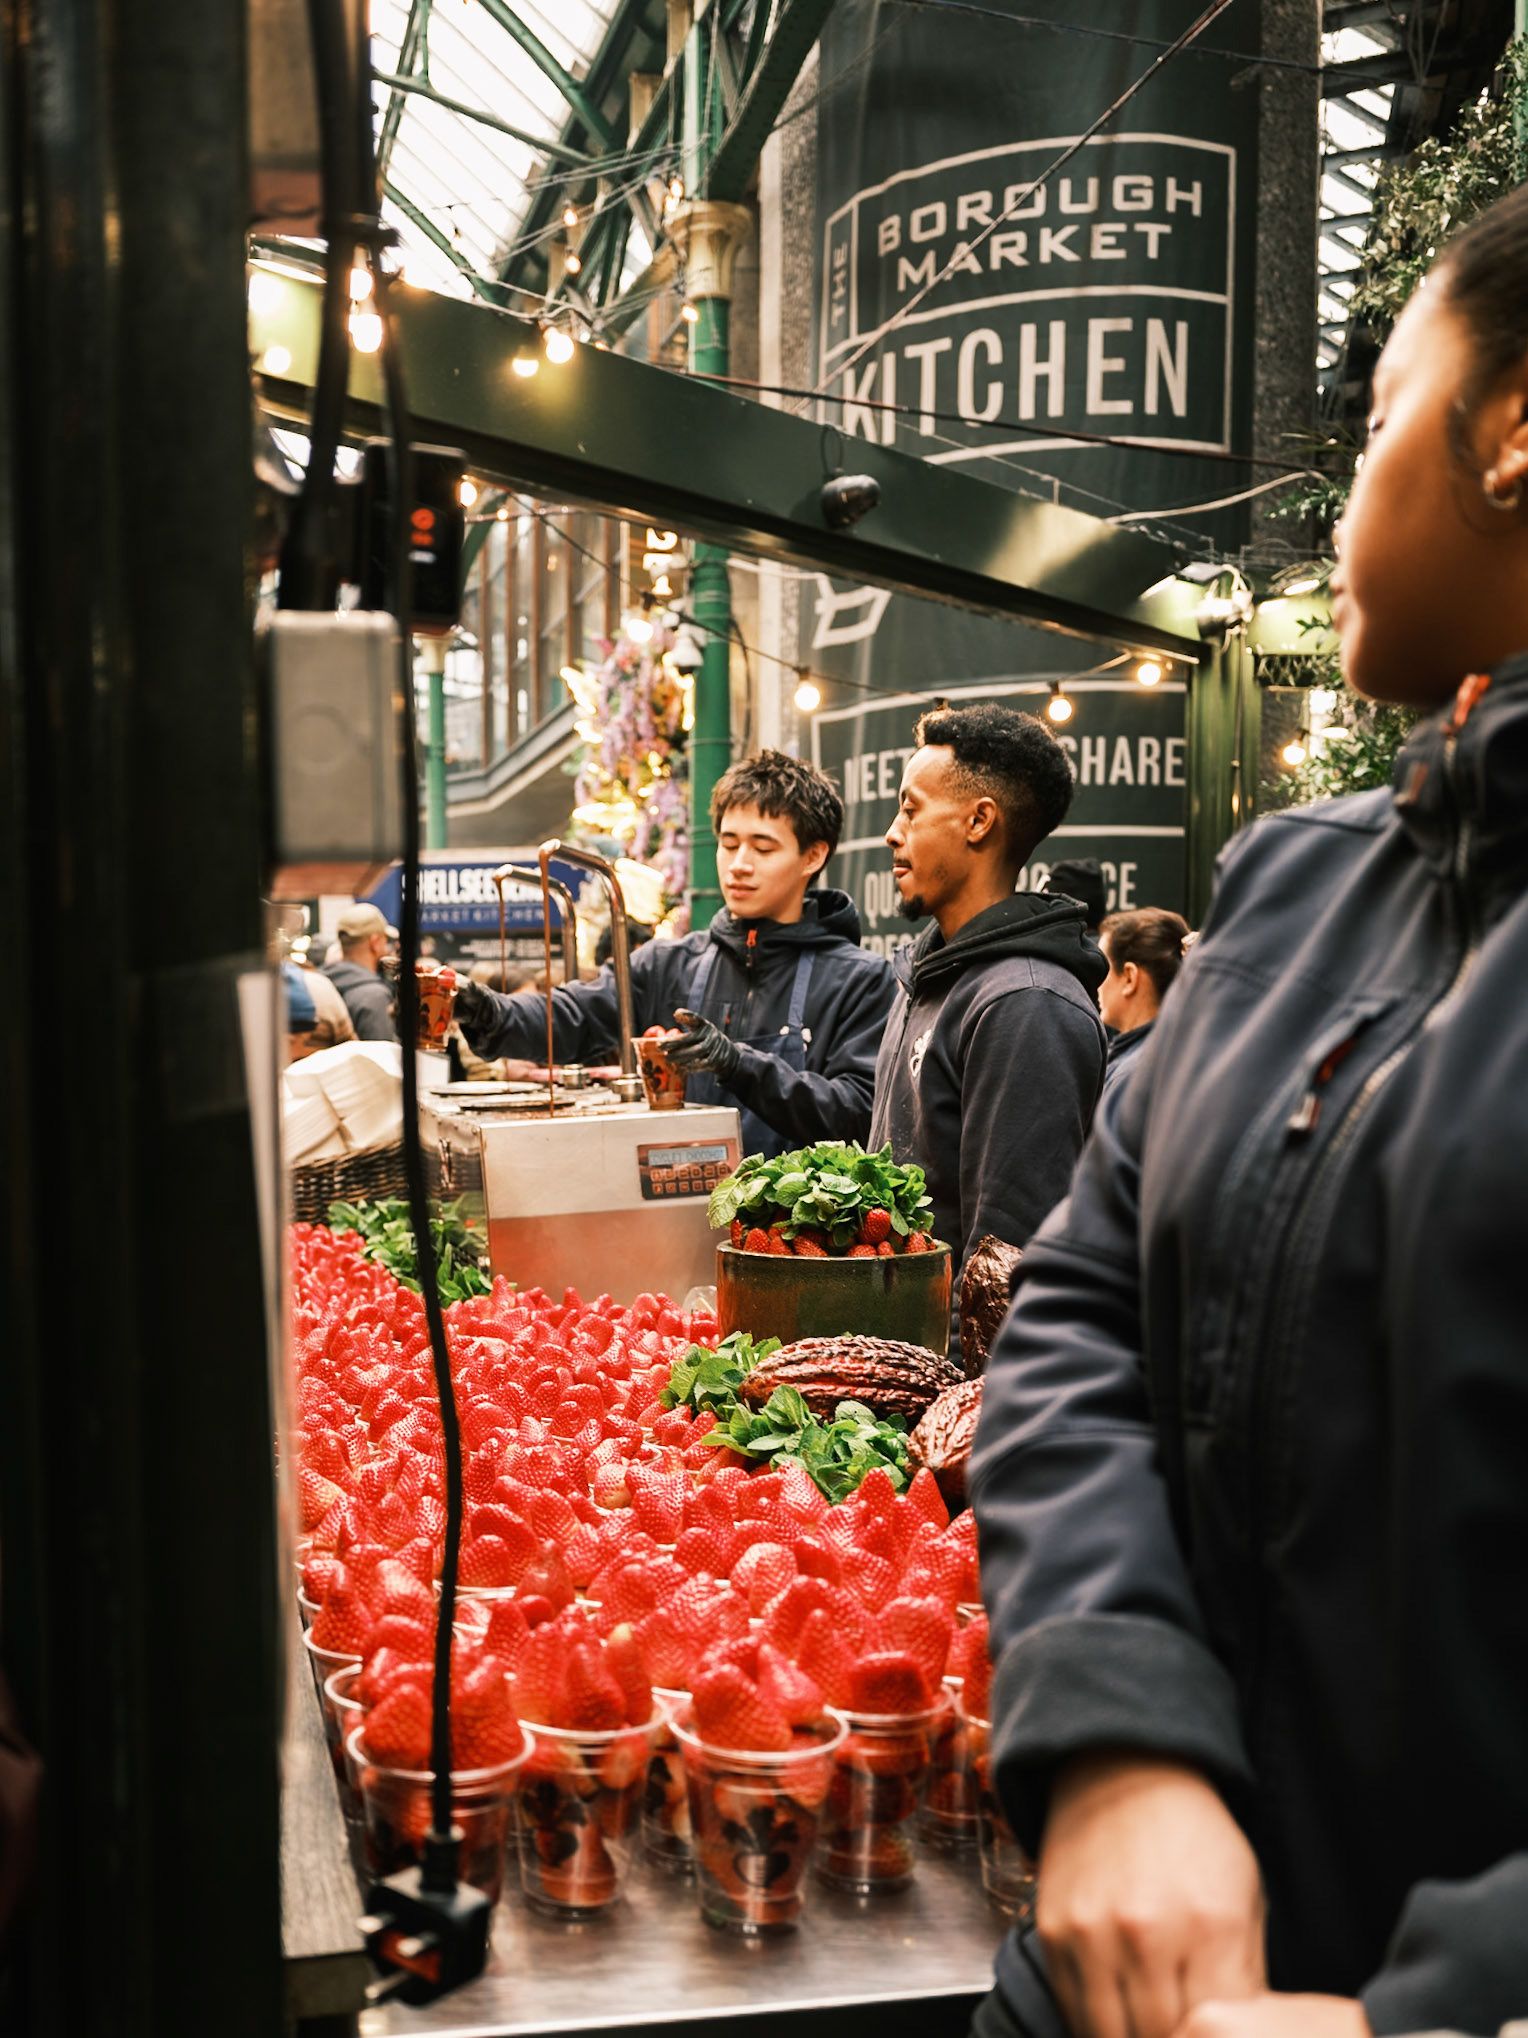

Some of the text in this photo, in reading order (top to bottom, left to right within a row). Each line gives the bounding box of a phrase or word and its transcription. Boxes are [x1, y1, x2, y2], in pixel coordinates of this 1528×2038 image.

[877, 174, 1202, 257] BOROUGH
[897, 222, 1172, 292] MARKET
[831, 242, 848, 328] THE
[842, 317, 1189, 447] KITCHEN
[1055, 734, 1188, 786] SHARE
